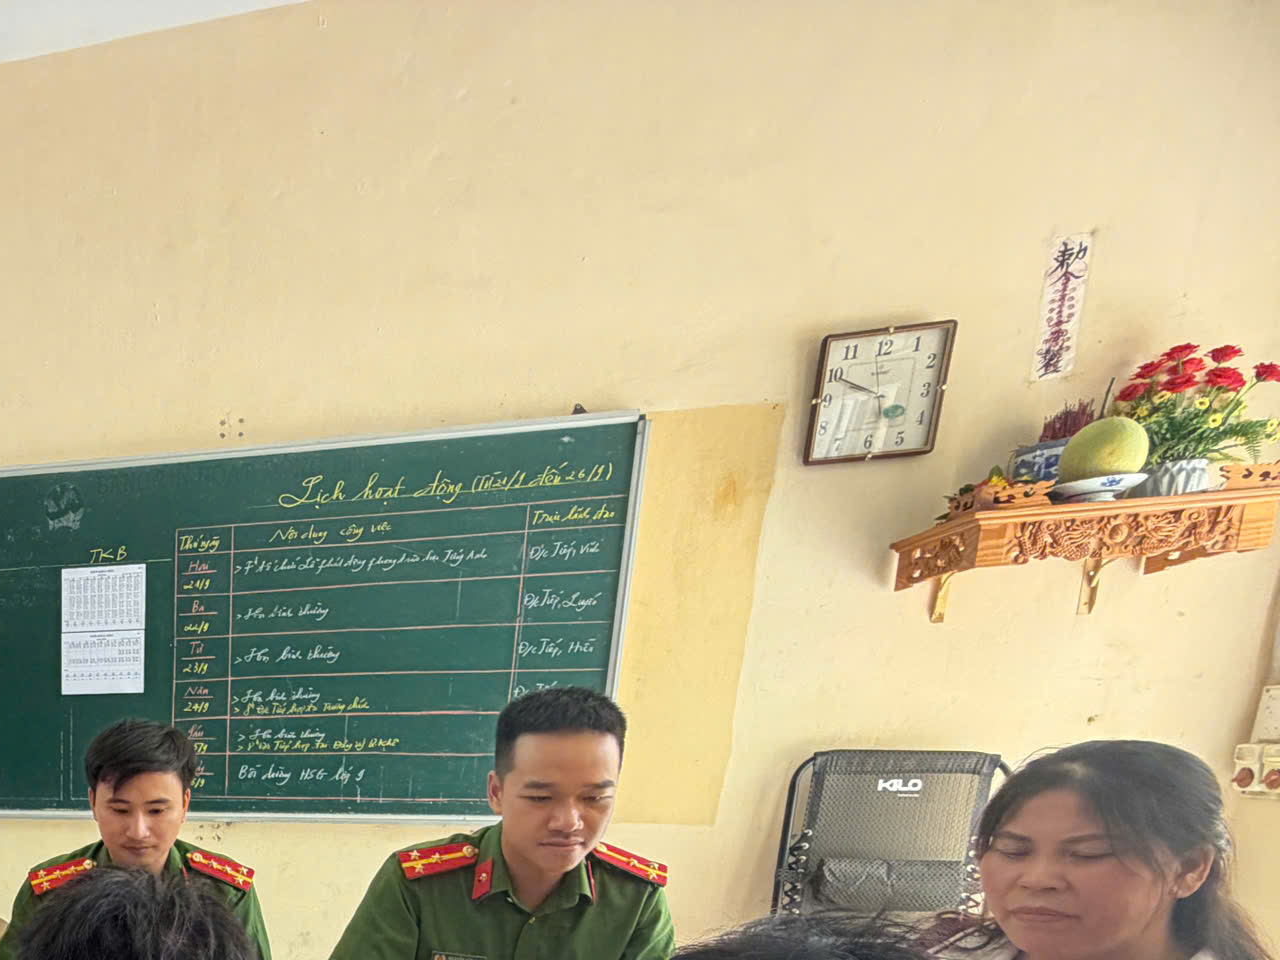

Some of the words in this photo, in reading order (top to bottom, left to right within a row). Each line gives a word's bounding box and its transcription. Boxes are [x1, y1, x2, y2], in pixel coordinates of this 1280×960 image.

[875, 339, 894, 357] 12
[912, 335, 922, 352] 1
[842, 343, 859, 361] 11
[925, 352, 937, 369] 2
[827, 367, 843, 383] 10
[920, 382, 931, 398] 3
[822, 392, 833, 408] 9
[915, 410, 925, 426] 4
[818, 420, 828, 435] 8
[864, 434, 873, 449] 6
[895, 431, 905, 446] 5
[278, 474, 345, 509] Lịch
[877, 778, 923, 791] KILO
